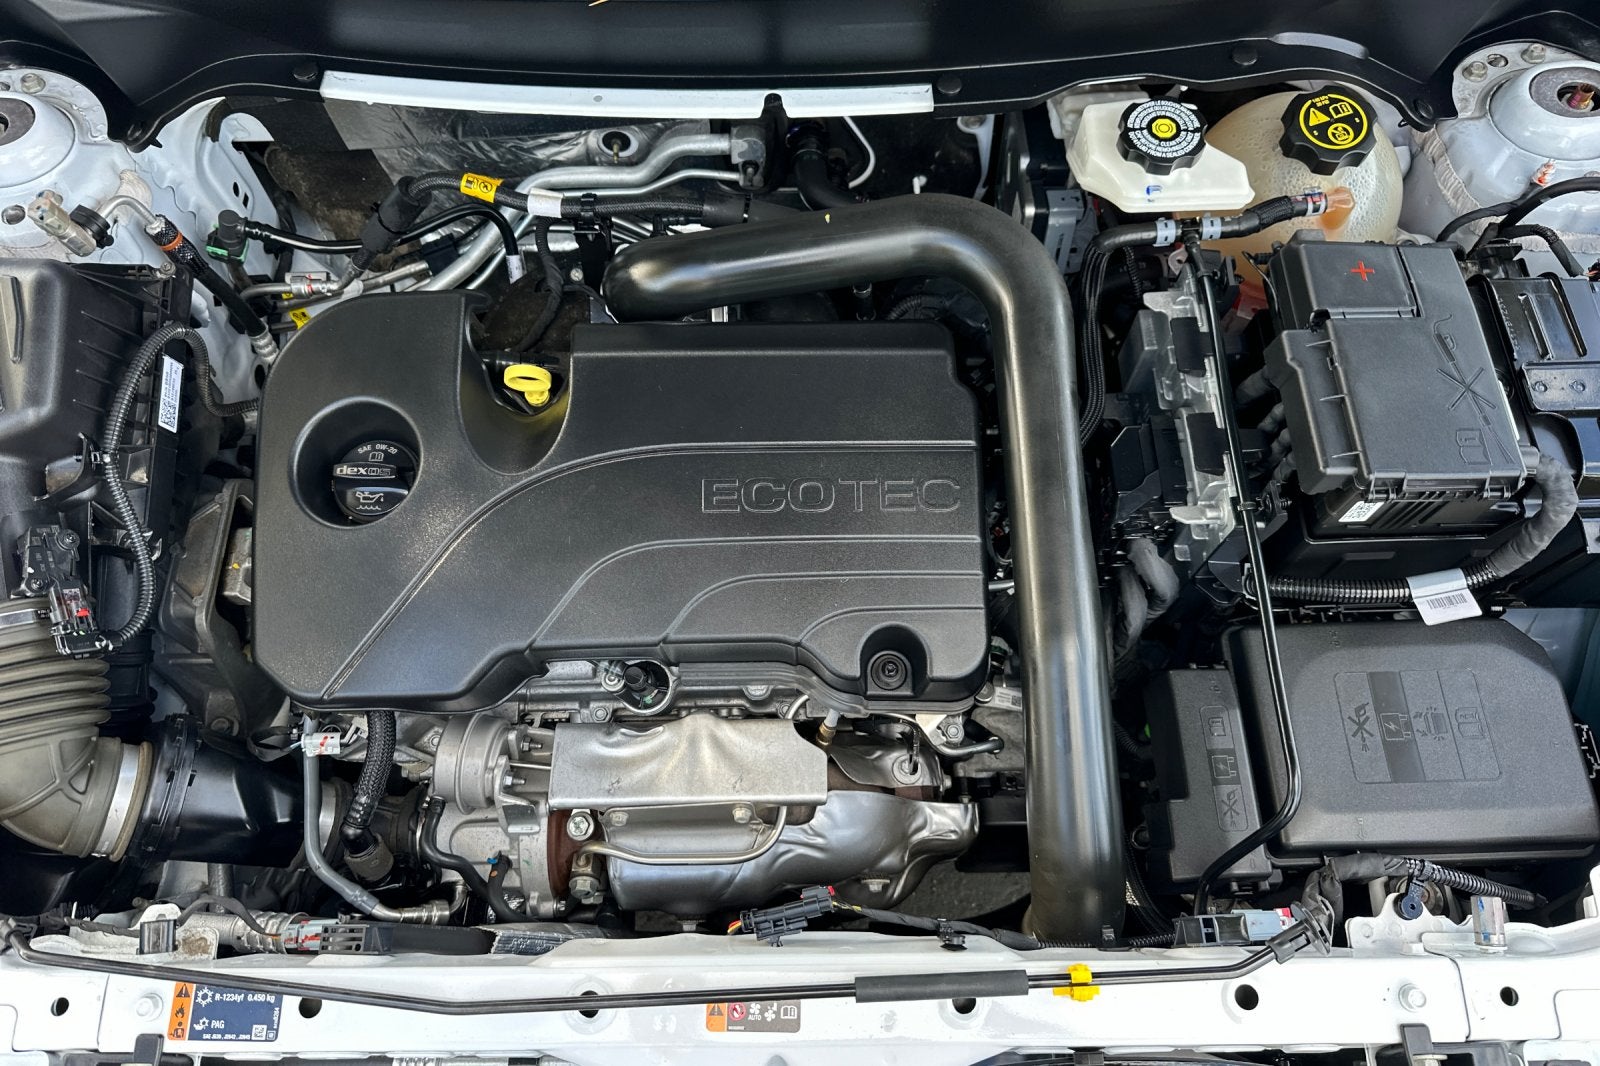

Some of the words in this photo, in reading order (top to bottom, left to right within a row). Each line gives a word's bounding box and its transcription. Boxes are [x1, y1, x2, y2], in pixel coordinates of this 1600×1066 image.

[1147, 149, 1161, 157] FROM
[358, 444, 372, 454] SAE
[376, 444, 398, 454] 0W-20
[700, 476, 960, 514] ECOTEC
[214, 994, 244, 1002] R-1234yf
[266, 995, 275, 1003] kg
[211, 1020, 225, 1029] PAG
